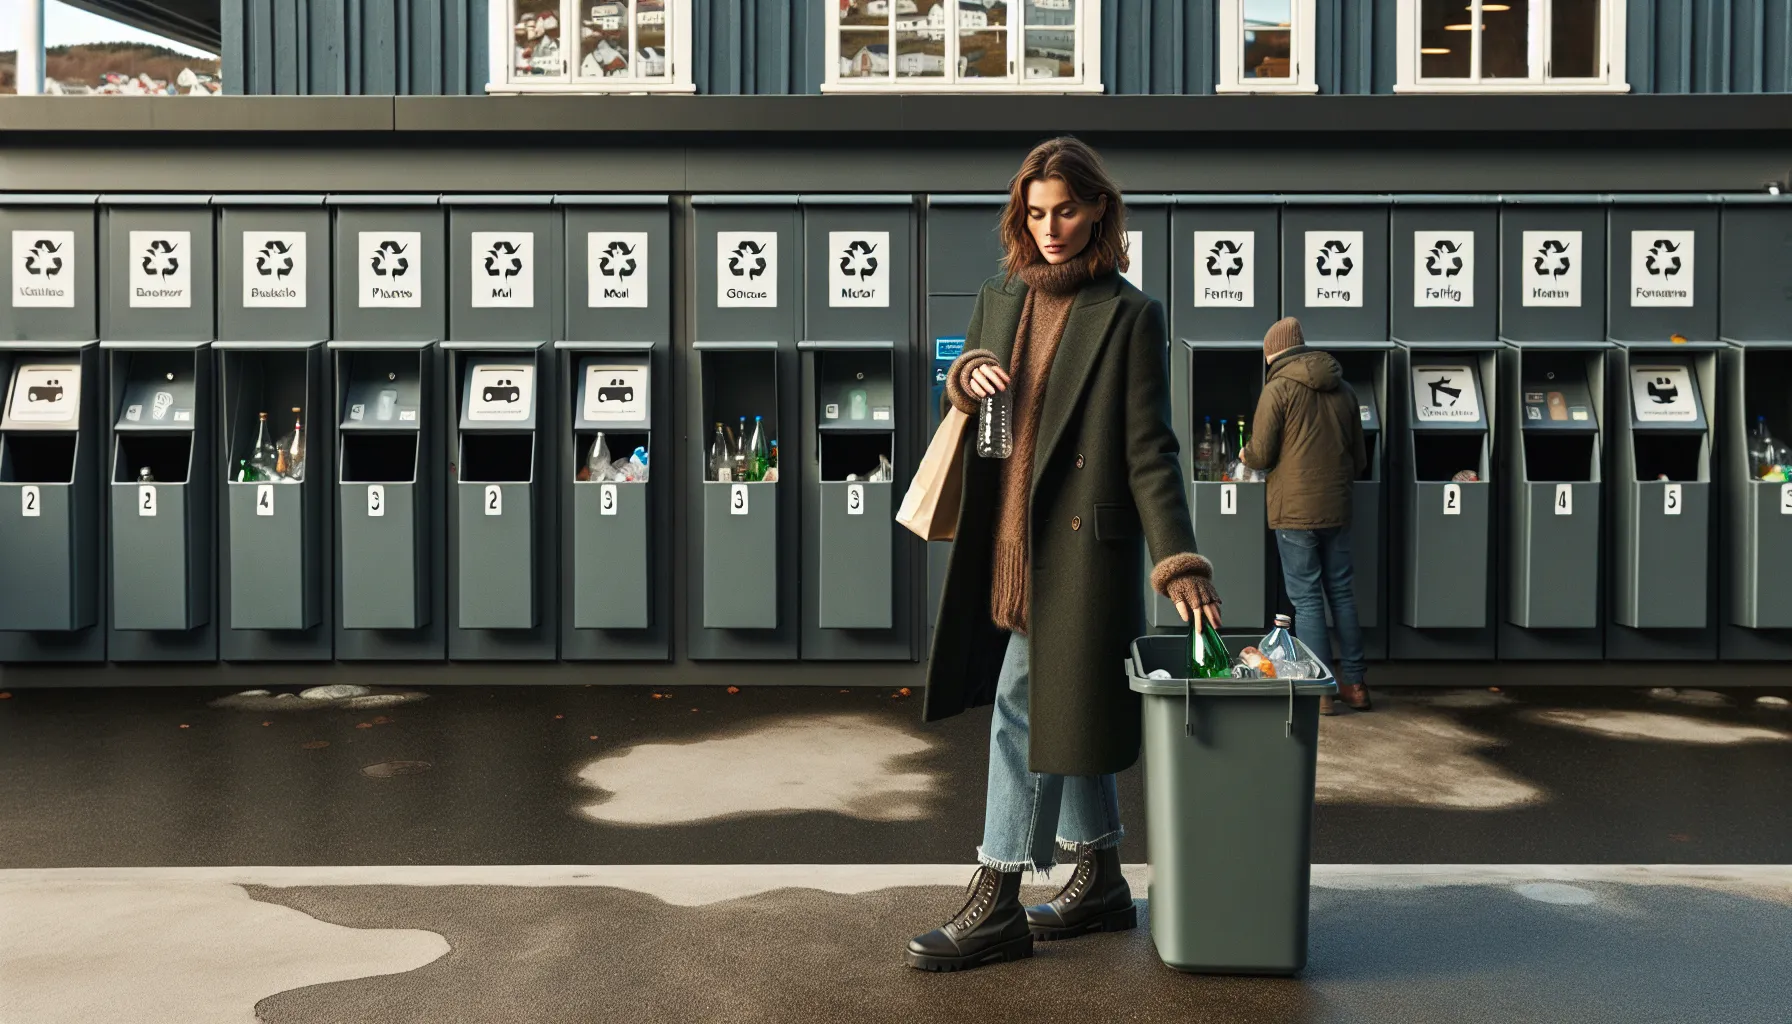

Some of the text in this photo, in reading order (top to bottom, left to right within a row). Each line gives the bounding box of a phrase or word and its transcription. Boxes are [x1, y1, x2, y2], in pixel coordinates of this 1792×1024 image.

[26, 491, 35, 510] 2
[143, 491, 152, 510] 2
[259, 491, 269, 509] 4
[489, 490, 498, 510] 2
[734, 490, 744, 509] 3
[1225, 490, 1232, 509] 1
[1558, 490, 1567, 509] 4
[1668, 490, 1677, 509] 5
